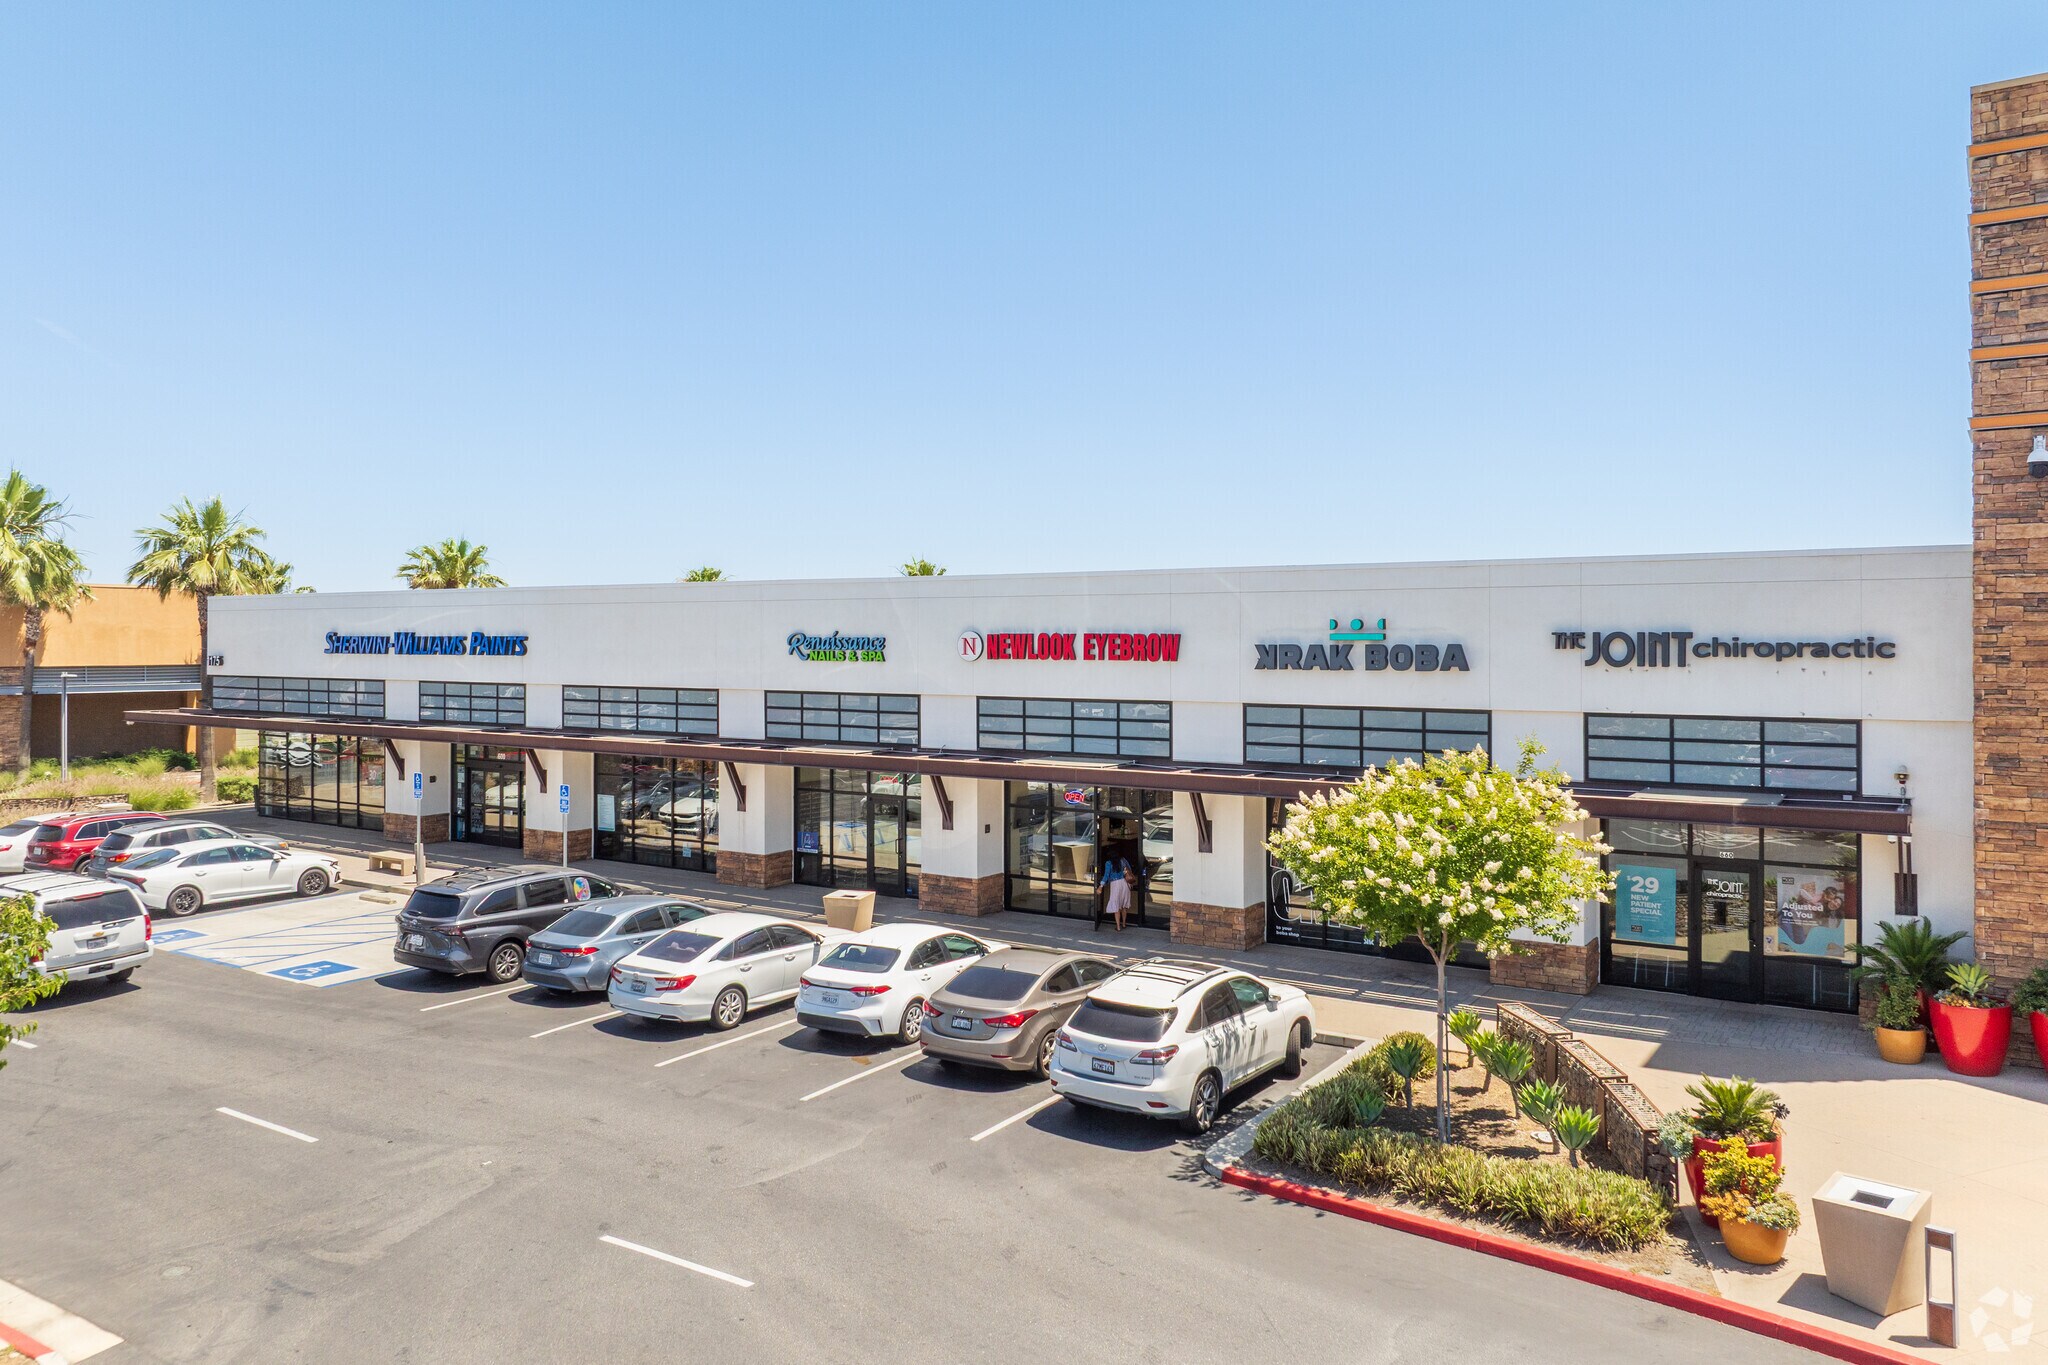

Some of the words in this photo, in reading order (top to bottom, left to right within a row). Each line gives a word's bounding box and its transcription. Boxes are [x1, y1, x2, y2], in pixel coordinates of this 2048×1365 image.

[324, 632, 467, 655] SHERWIN-WILLIAMS
[469, 632, 528, 656] PAINTS
[786, 630, 886, 660] Renaissance
[961, 637, 976, 655] N
[986, 632, 1077, 660] NEWLOOK
[1083, 633, 1181, 661] EYEBROW
[1551, 631, 1586, 649] THE
[1585, 631, 1693, 667] JOINT
[1692, 637, 1896, 662] chiropractic
[809, 650, 847, 661] NAILS
[848, 650, 859, 661] &
[860, 650, 886, 661] SPA
[1365, 643, 1470, 671] BOBA
[1065, 792, 1085, 802] OPEN
[1707, 878, 1718, 886] THE
[1716, 881, 1744, 894] JOINT
[1630, 894, 1650, 902] NEW
[1706, 891, 1744, 900] chiropractic
[1630, 900, 1662, 909] PATIENT
[1782, 902, 1824, 912] Adjusted
[1630, 907, 1663, 916] SPECIAL
[1795, 911, 1813, 919] You
